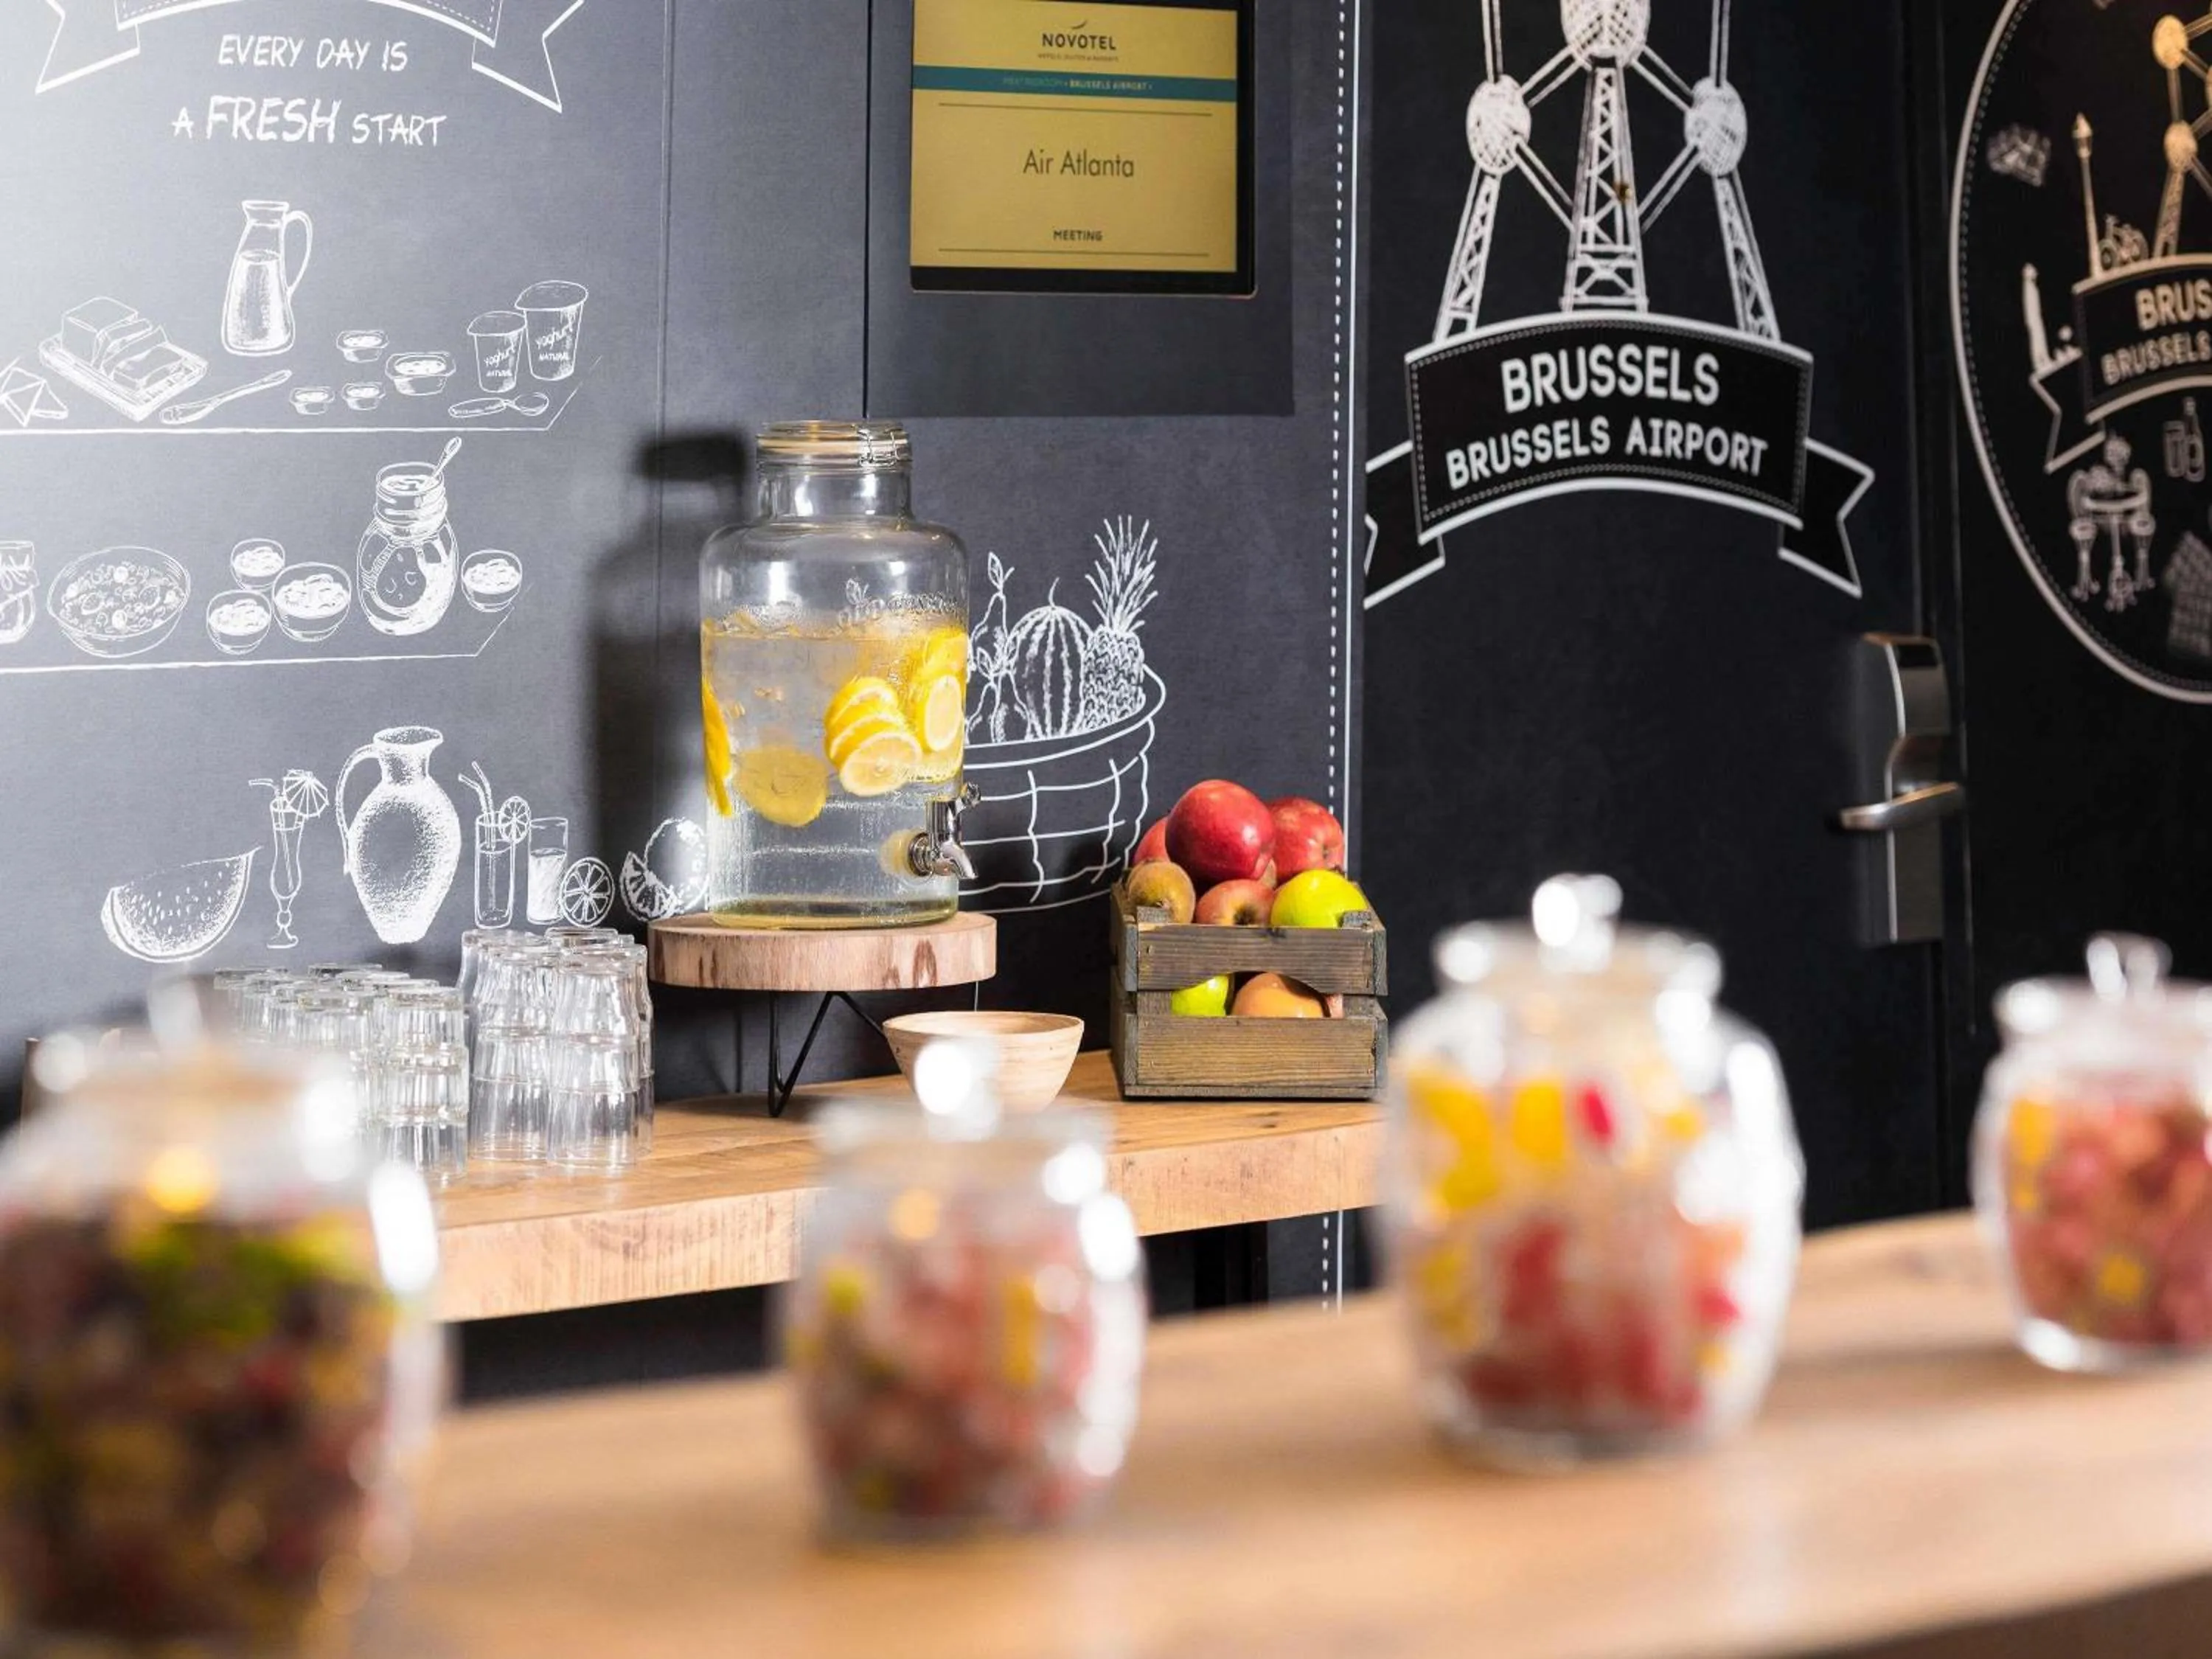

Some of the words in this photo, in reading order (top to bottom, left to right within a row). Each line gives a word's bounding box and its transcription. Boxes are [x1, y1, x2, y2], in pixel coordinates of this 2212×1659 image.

[218, 34, 304, 67] EVERY
[316, 38, 371, 70] DAY
[381, 41, 408, 72] IS
[1042, 33, 1117, 51] NOVOTEL
[171, 106, 195, 139] A
[205, 94, 342, 144] FRESH
[352, 113, 448, 147] START
[1023, 149, 1054, 175] Air
[1060, 149, 1135, 178] Atlanta
[1053, 229, 1103, 242] MEETING
[1500, 344, 1719, 414] BRUSSELS
[2102, 330, 2211, 385] BRUSSELS
[1445, 417, 1611, 491] BRUSSELS
[1624, 417, 1768, 476] AIRPORT
